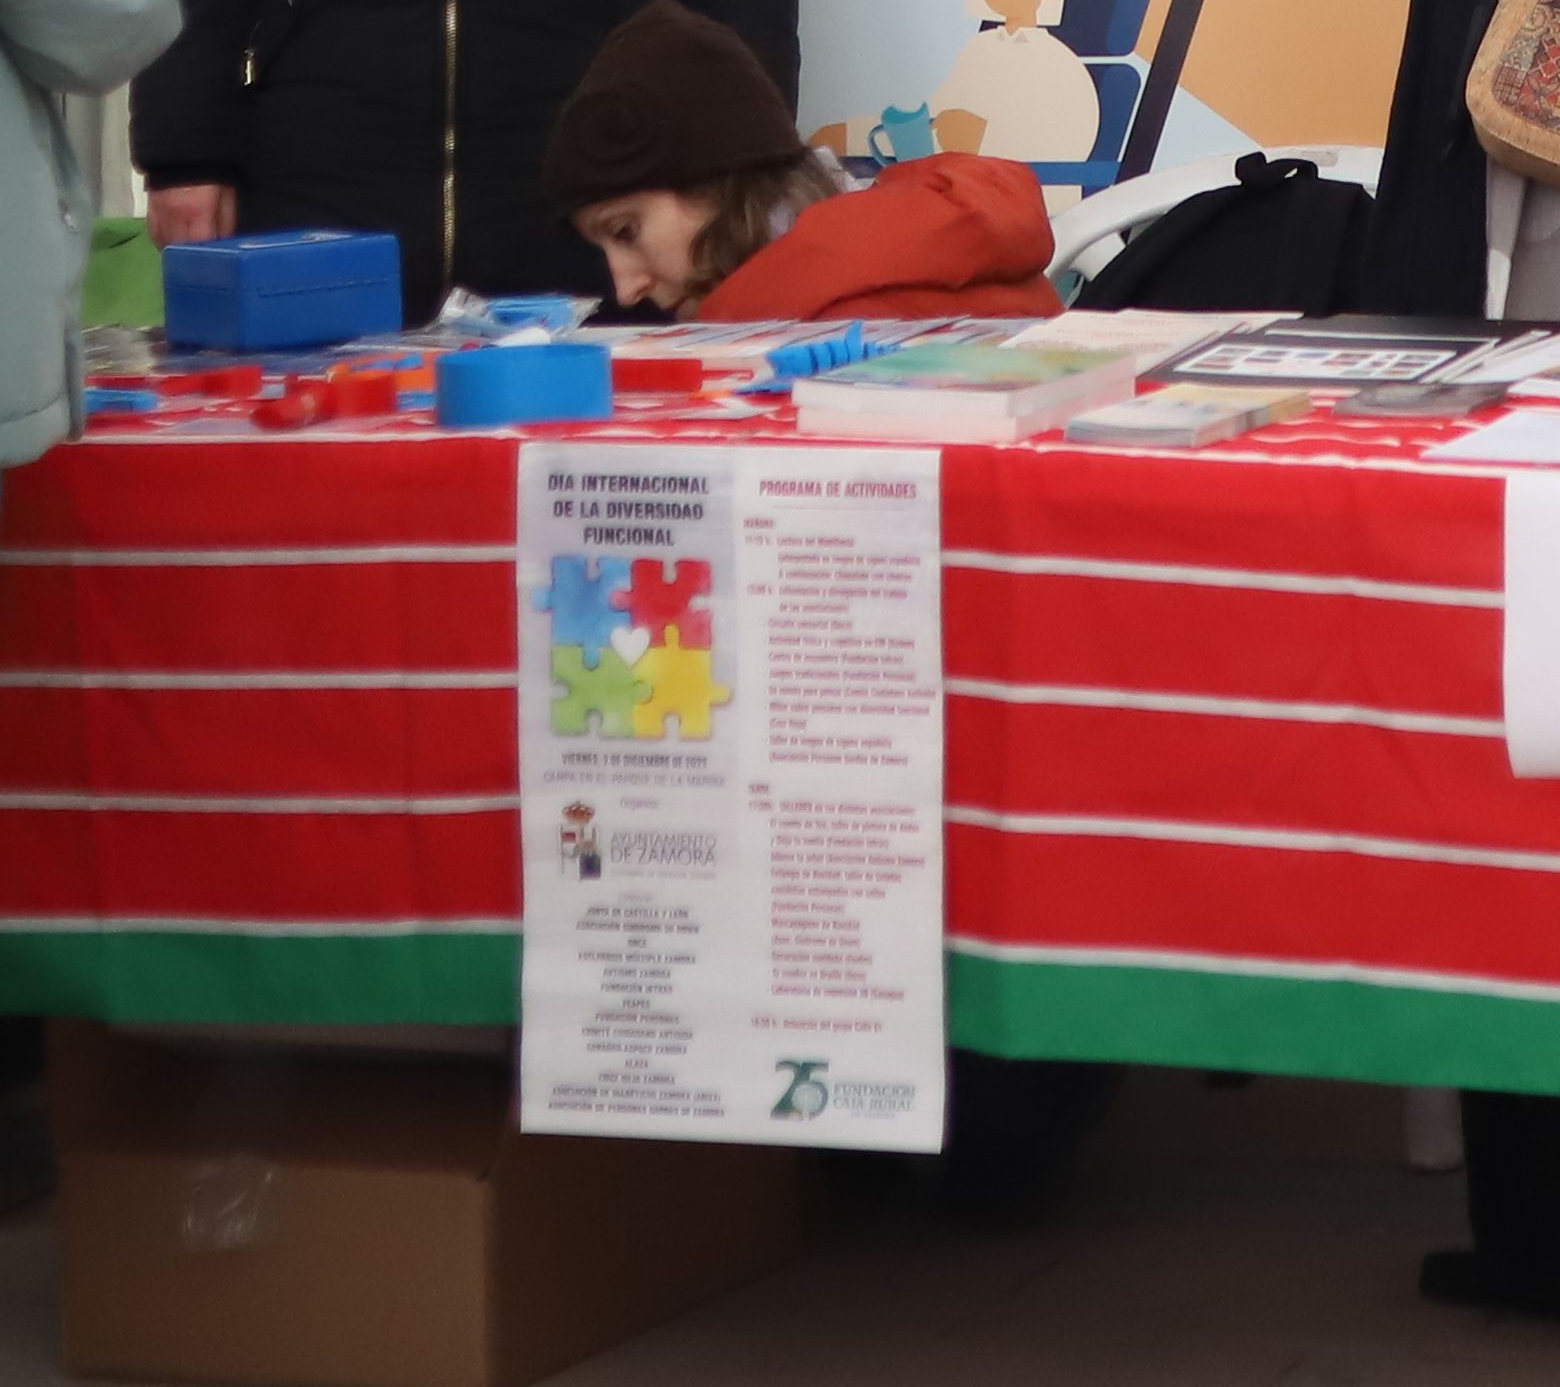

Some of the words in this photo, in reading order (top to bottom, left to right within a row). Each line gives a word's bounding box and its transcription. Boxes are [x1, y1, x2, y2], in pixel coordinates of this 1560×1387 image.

[548, 474, 573, 491] DIA
[582, 475, 710, 494] INTERNACIONAL
[759, 480, 822, 497] PROGRAMA
[826, 481, 840, 497] DE
[844, 482, 917, 499] ACTIVIDADES
[553, 501, 573, 518] DE
[580, 501, 600, 518] LA
[606, 501, 704, 520] DIVERSIDAD
[583, 527, 674, 547] FUNCIONAL
[611, 833, 717, 849] AYUNTAMIENTO
[611, 848, 631, 863] DE
[637, 848, 715, 865] ZAMORA
[770, 1060, 829, 1120] 25
[833, 1098, 864, 1111] CAJA
[869, 1098, 915, 1113] RURAL
